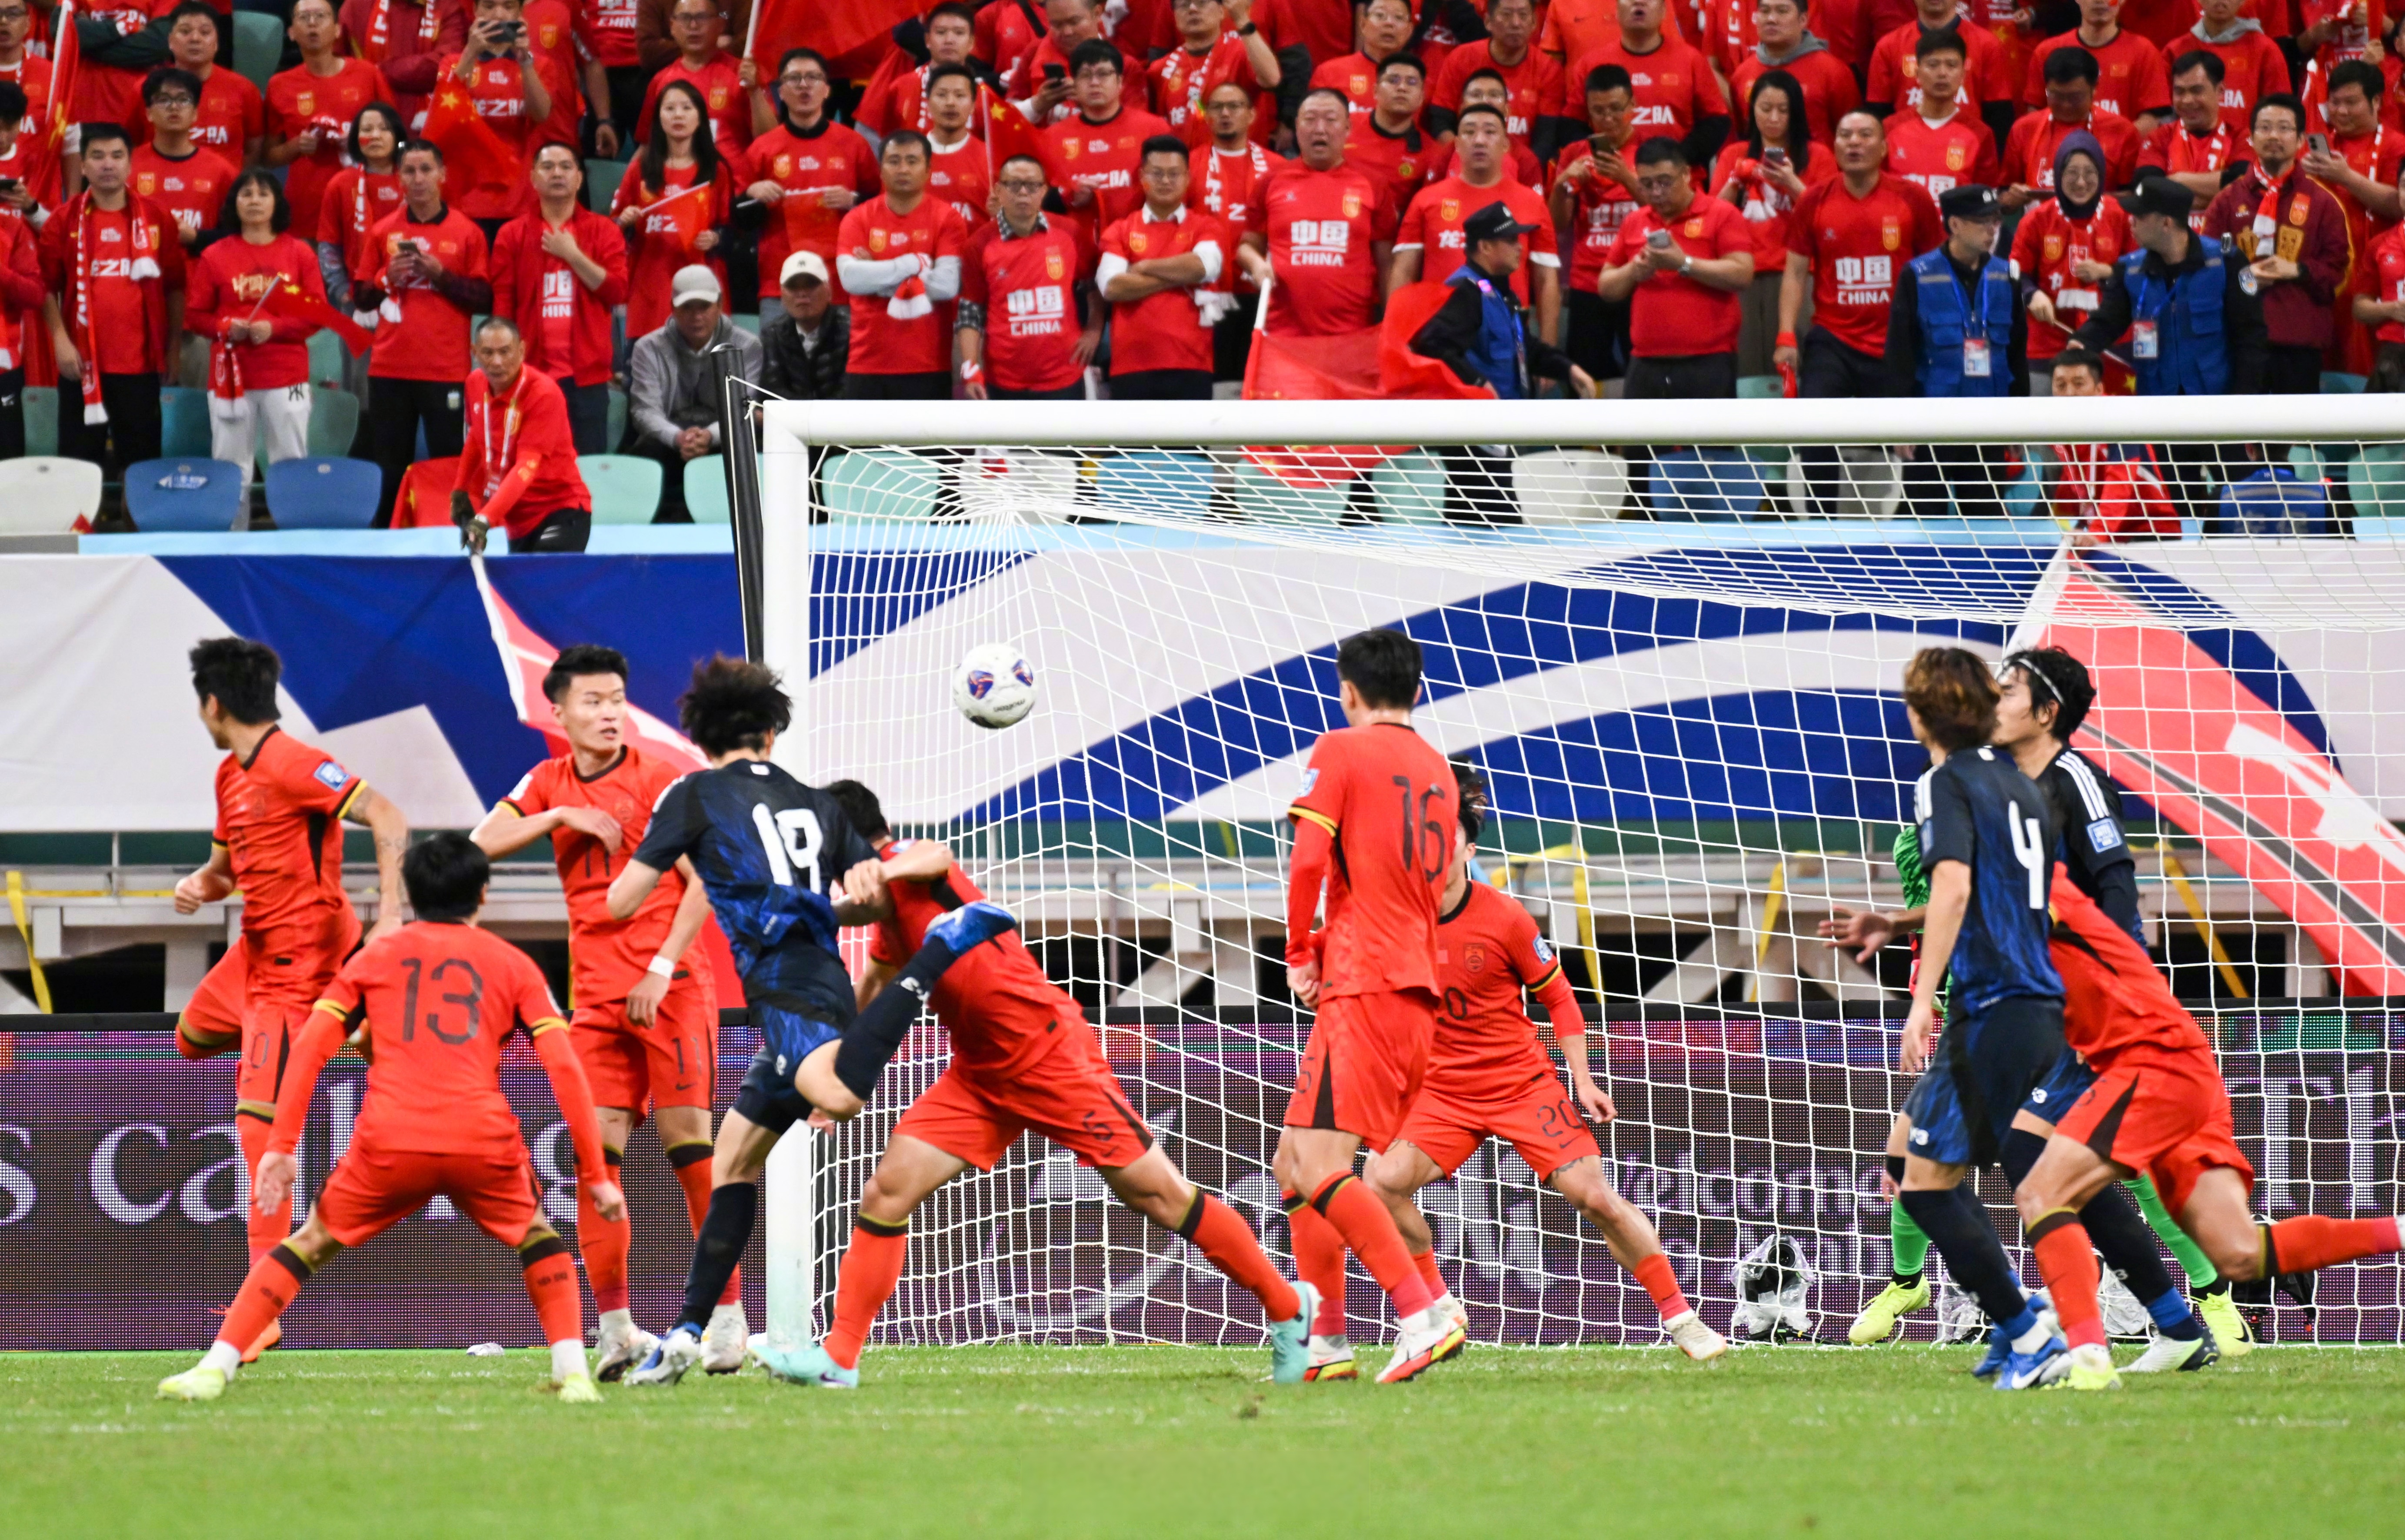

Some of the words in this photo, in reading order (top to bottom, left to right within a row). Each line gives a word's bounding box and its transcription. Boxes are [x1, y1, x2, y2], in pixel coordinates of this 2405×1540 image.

[1290, 220, 1349, 245] 中国
[1291, 253, 1345, 267] CHINA
[1835, 256, 1892, 284] 中国
[543, 306, 573, 318] HIN
[1008, 286, 1064, 315] 中国
[1838, 290, 1889, 305] CHINA
[1010, 322, 1062, 336] CHINA
[1392, 775, 1445, 883] 16
[752, 802, 822, 895] 19
[2008, 800, 2044, 910] 4
[401, 958, 483, 1045] 13
[672, 1037, 702, 1075] 11
[1537, 1099, 1582, 1137] 20
